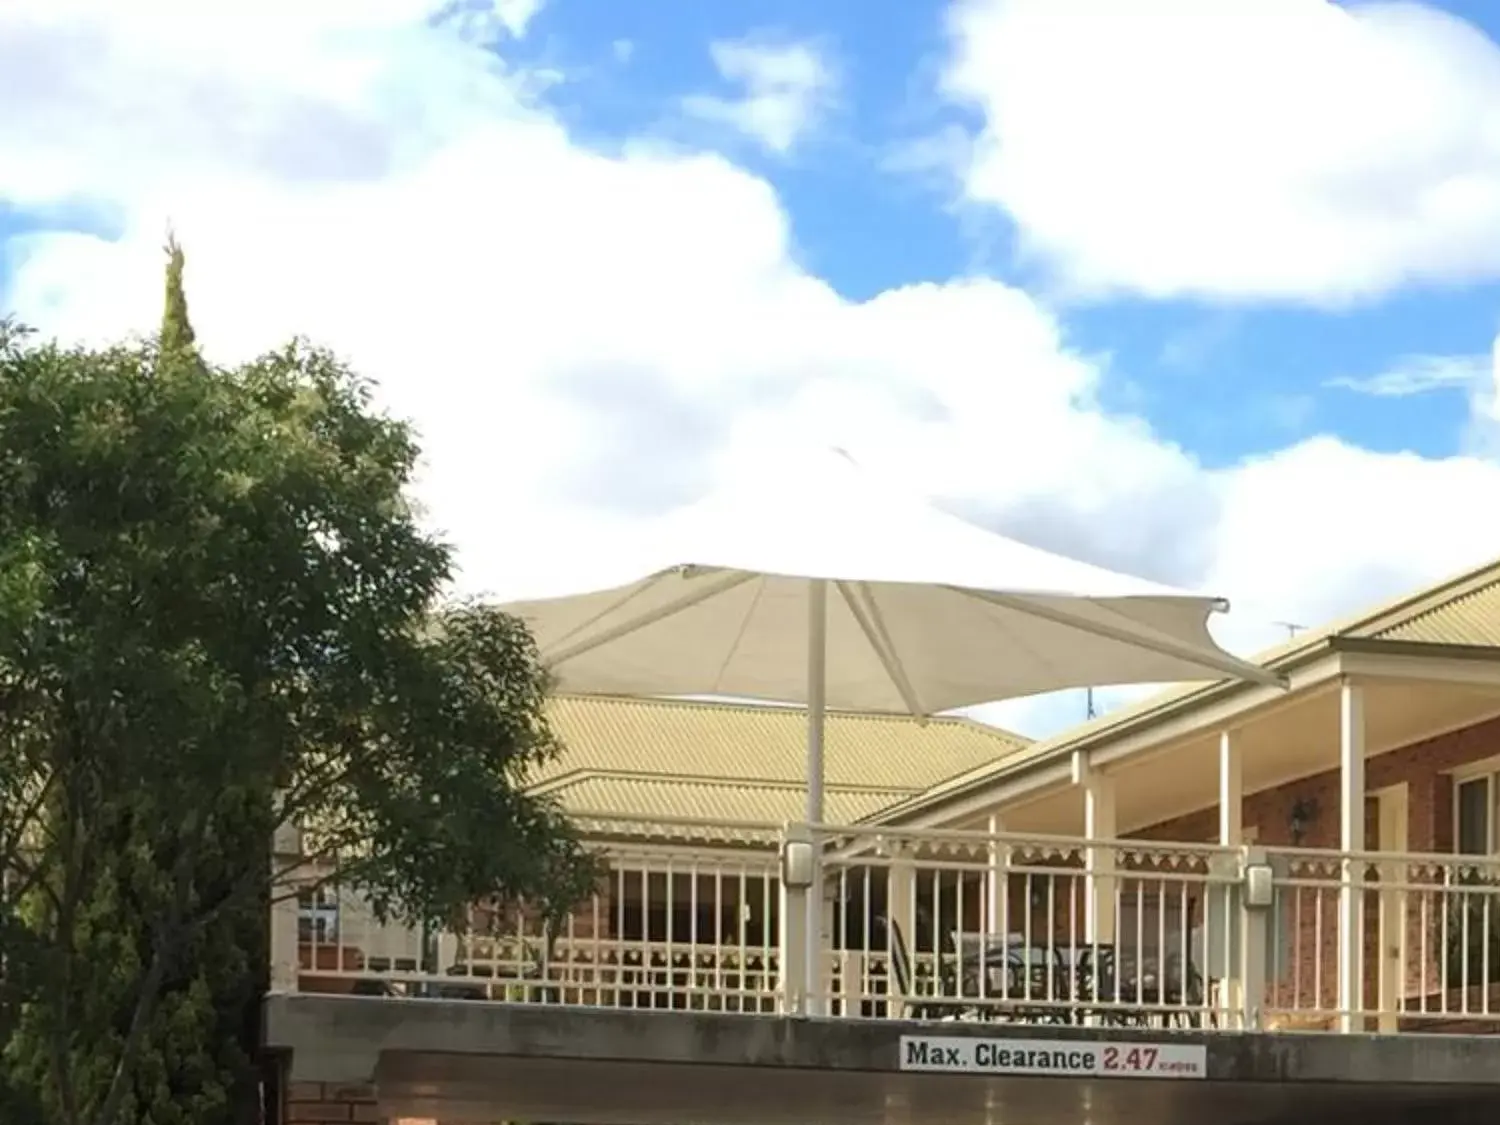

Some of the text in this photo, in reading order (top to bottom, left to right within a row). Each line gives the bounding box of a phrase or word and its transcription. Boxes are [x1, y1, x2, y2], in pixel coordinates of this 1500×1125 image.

[906, 1041, 1159, 1071] Max. Clearance 2.47
